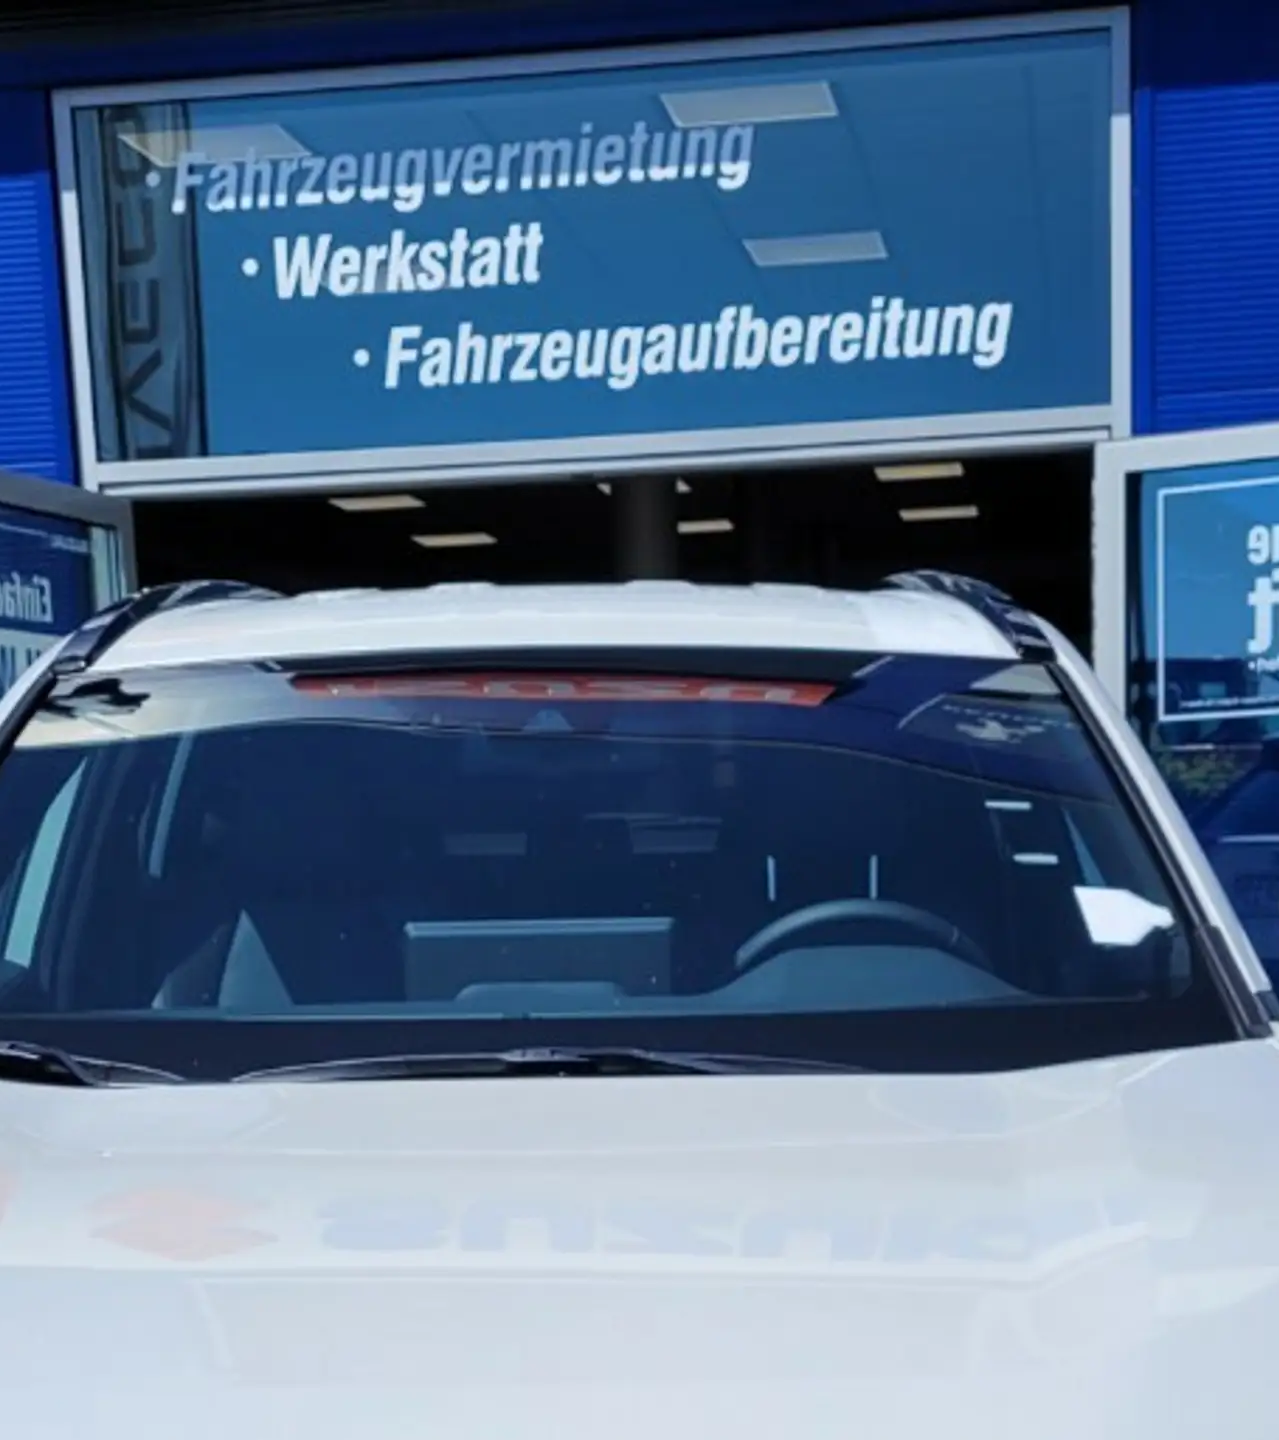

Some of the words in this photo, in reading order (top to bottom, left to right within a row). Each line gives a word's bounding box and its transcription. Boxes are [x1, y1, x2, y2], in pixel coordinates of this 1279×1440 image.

[170, 120, 756, 214] Fahrzeugvermietung
[271, 222, 544, 300] Werkstatt
[383, 296, 1014, 391] Fahrzeugaufbereitung
